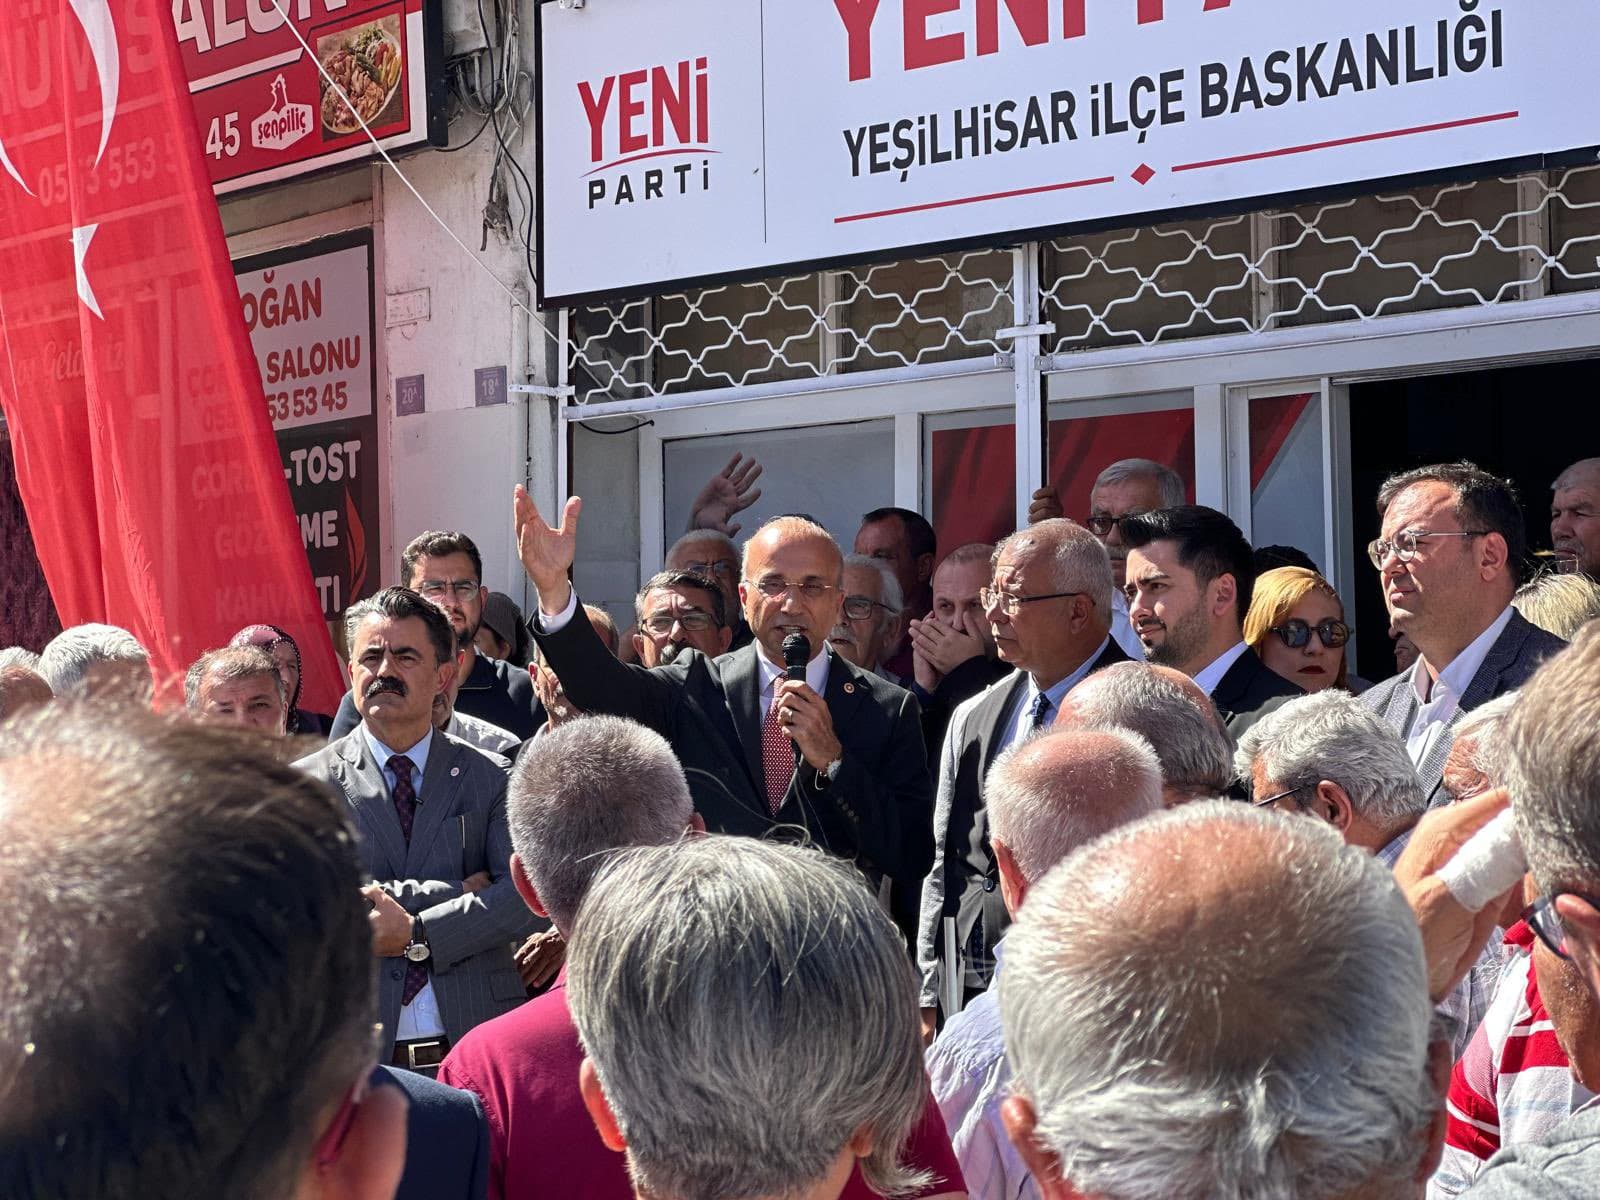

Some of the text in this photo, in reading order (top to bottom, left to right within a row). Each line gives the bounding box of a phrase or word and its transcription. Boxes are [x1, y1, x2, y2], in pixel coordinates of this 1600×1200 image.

[205, 111, 241, 160] 45
[257, 107, 307, 144] şenpiliç
[240, 270, 322, 332] OĞAN
[266, 334, 361, 384] SALONU
[293, 386, 318, 417] 53
[321, 380, 348, 412] 45
